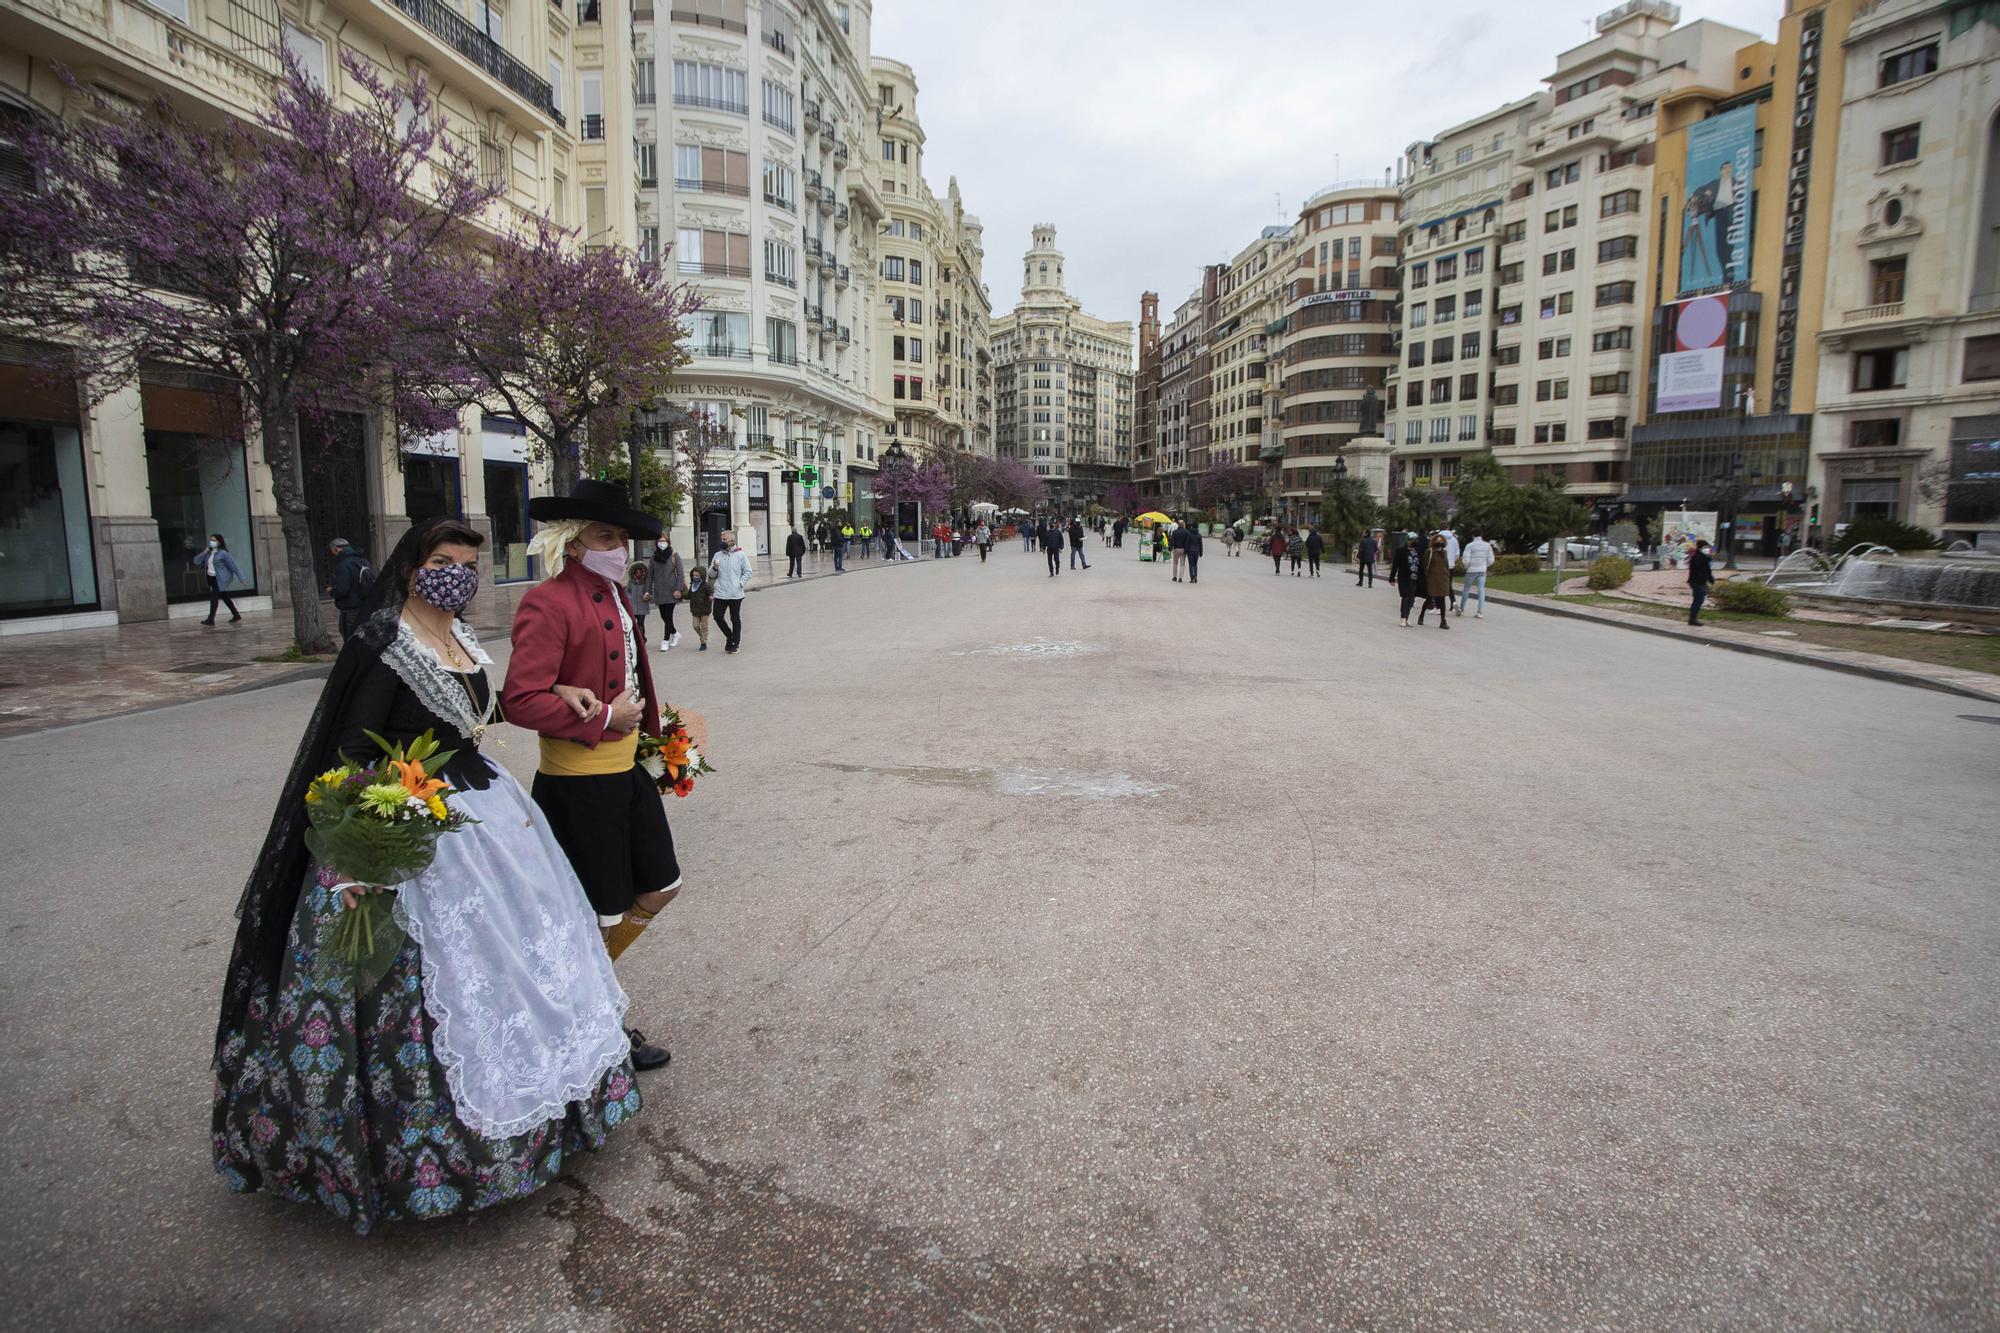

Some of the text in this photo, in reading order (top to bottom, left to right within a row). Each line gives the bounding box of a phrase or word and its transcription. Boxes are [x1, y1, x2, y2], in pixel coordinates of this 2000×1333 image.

[1725, 145, 1750, 270] la filmoteca
[698, 384, 746, 397] VENECIA
[1773, 264, 1800, 407] FILMOTECA
